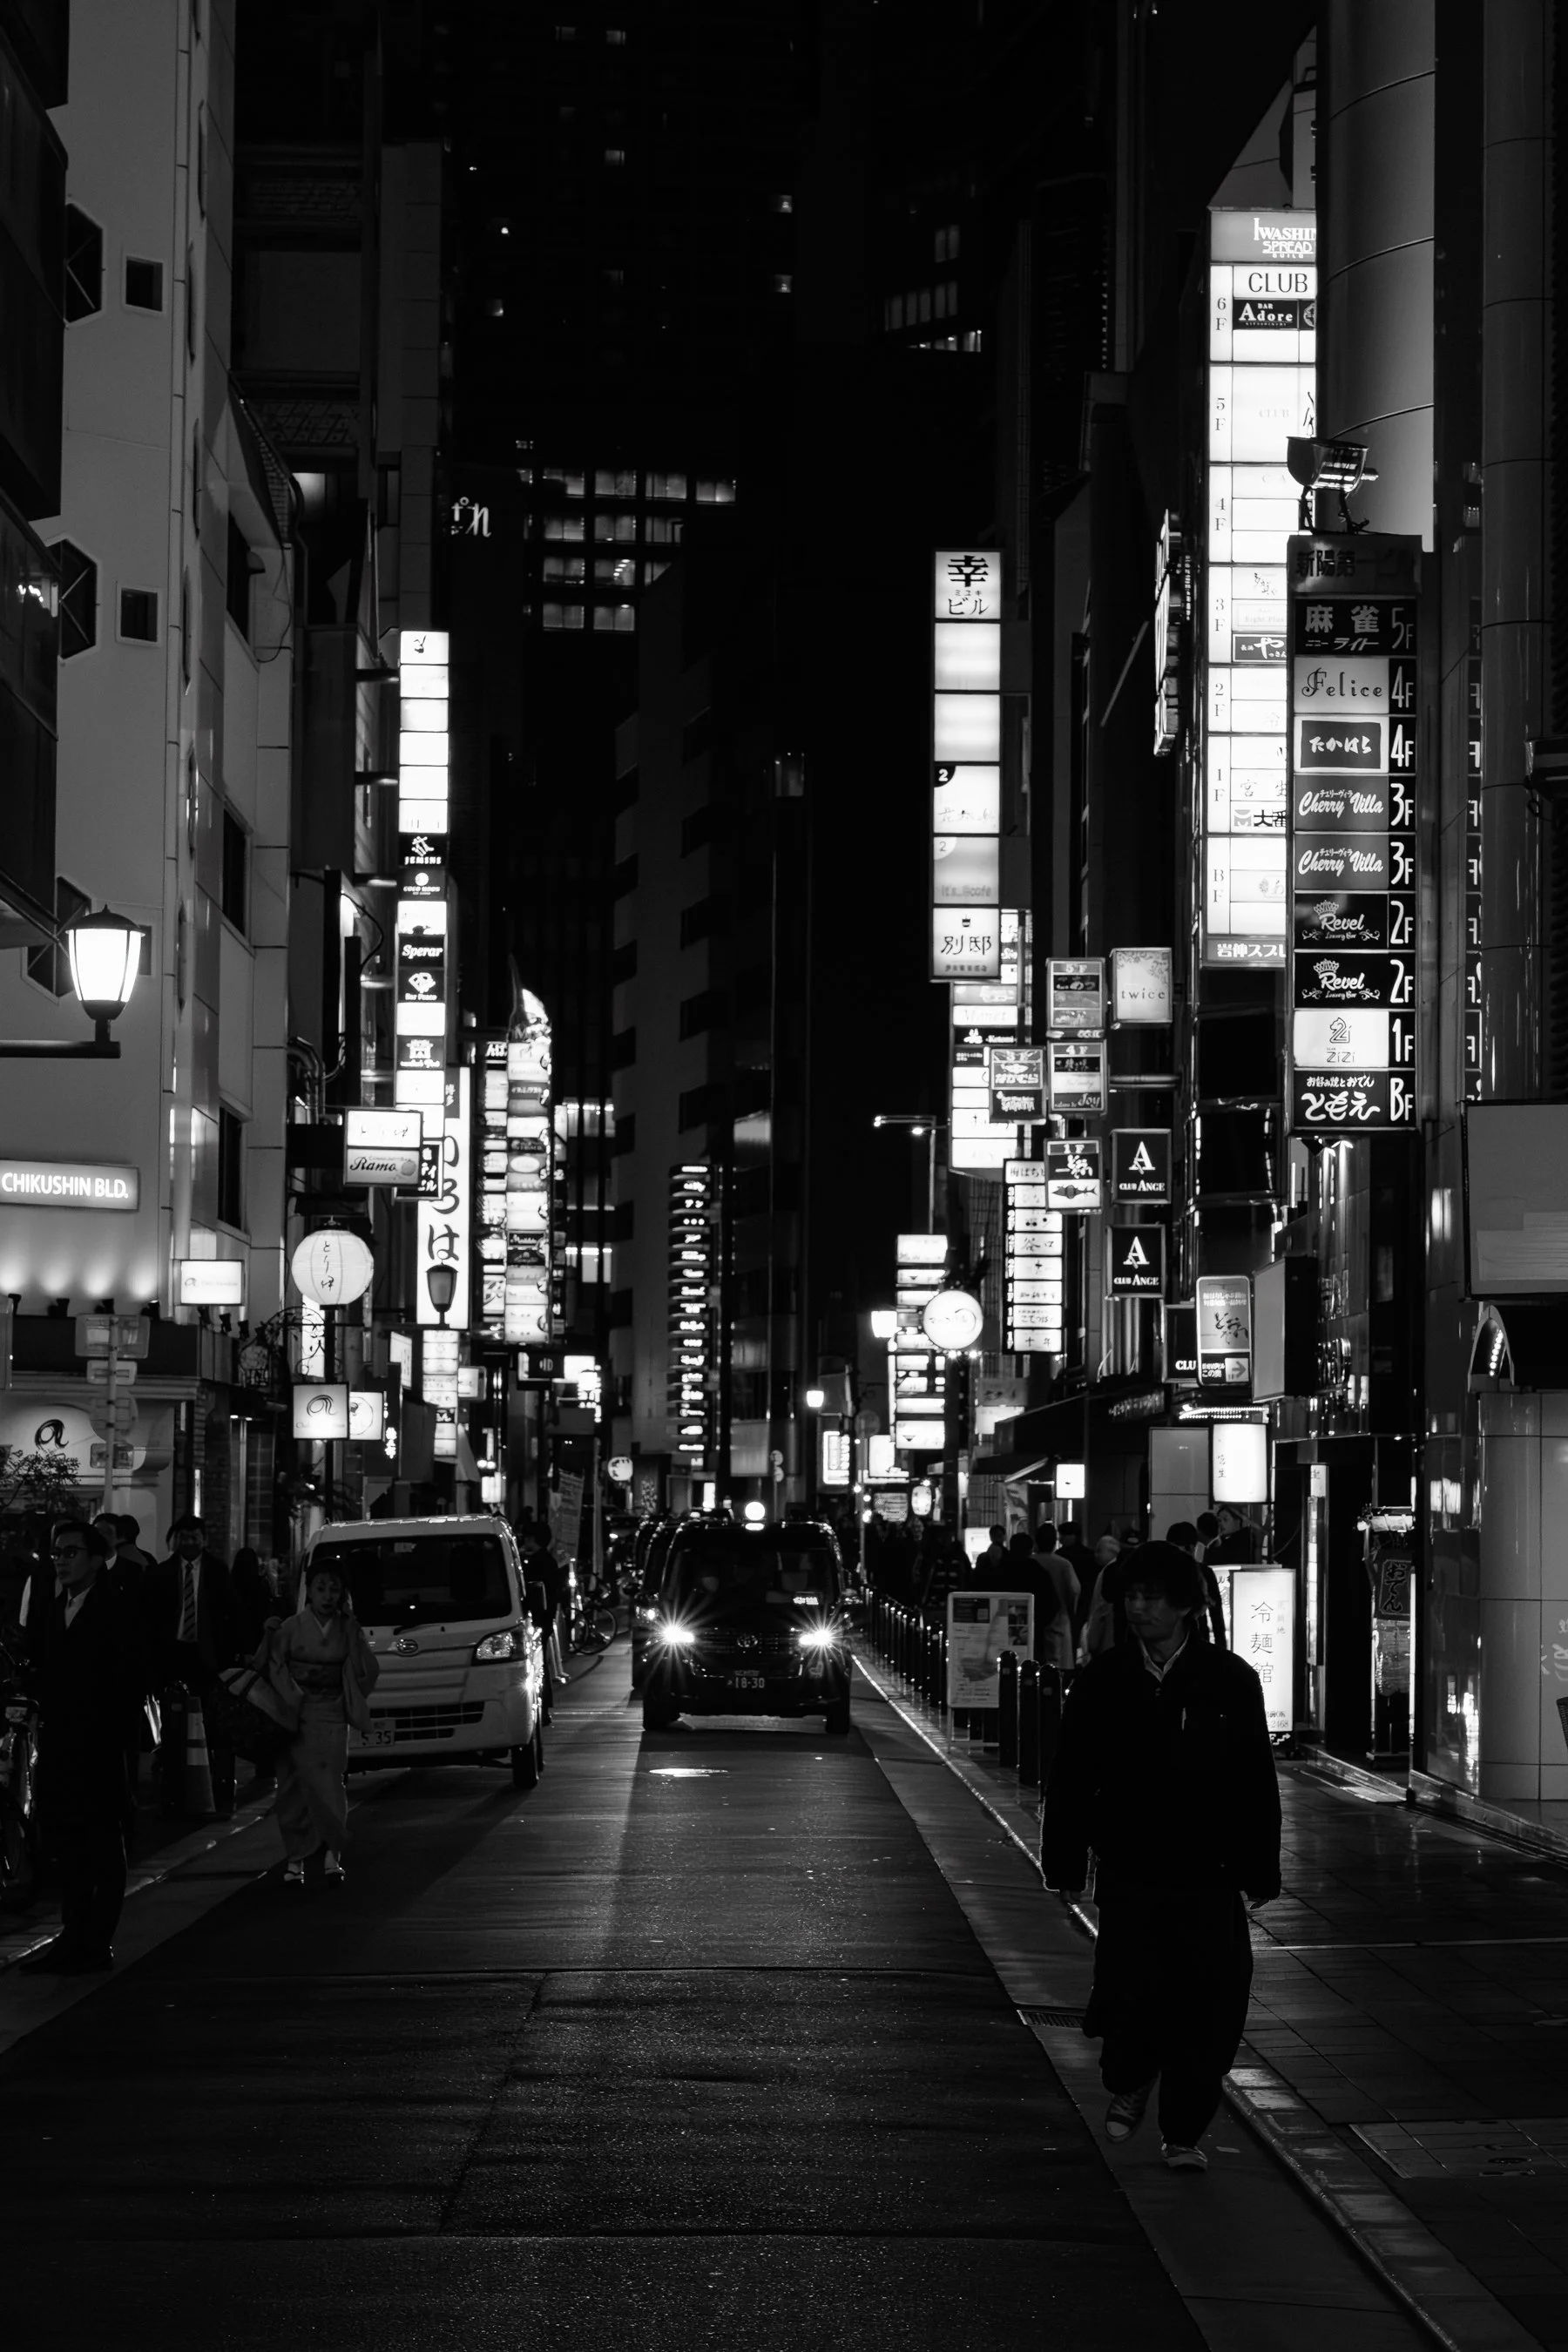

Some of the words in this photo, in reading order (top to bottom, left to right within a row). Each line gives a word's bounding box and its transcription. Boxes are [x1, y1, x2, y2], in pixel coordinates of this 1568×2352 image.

[1262, 240, 1314, 254] SPREAD
[1248, 273, 1308, 294] CLUB
[1239, 302, 1293, 322] Adore
[946, 554, 990, 588] 幸
[948, 598, 990, 616] ビル
[1304, 604, 1380, 634] 麻雀
[1390, 606, 1414, 650] 5F
[1301, 667, 1383, 698] Felice
[1391, 666, 1415, 709] 4F
[1308, 736, 1373, 755] たかはら
[1390, 724, 1415, 768] 4F
[1298, 791, 1345, 819] Cherry
[1350, 792, 1384, 814] Villa
[1389, 782, 1414, 827] 3F
[1298, 849, 1345, 877] Cherry
[1350, 850, 1384, 873] Villa
[1389, 841, 1414, 885] 3F
[1319, 912, 1365, 932] Revel
[1389, 900, 1414, 944] 2F
[402, 944, 443, 960] Sperar
[1121, 987, 1166, 999] twice
[1318, 971, 1365, 990] Revel
[1389, 959, 1414, 1004] 2F
[1391, 1017, 1414, 1062] 1F
[1301, 1091, 1381, 1121] ともえ
[1389, 1077, 1414, 1122] BF
[2, 1172, 91, 1197] CHIKUSHIN
[94, 1177, 129, 1199] BLD.
[1119, 1182, 1137, 1191] CLUB
[1175, 1360, 1196, 1371] CLU
[1383, 1562, 1407, 1613] おでん
[1250, 1601, 1274, 1684] 冷麺館
